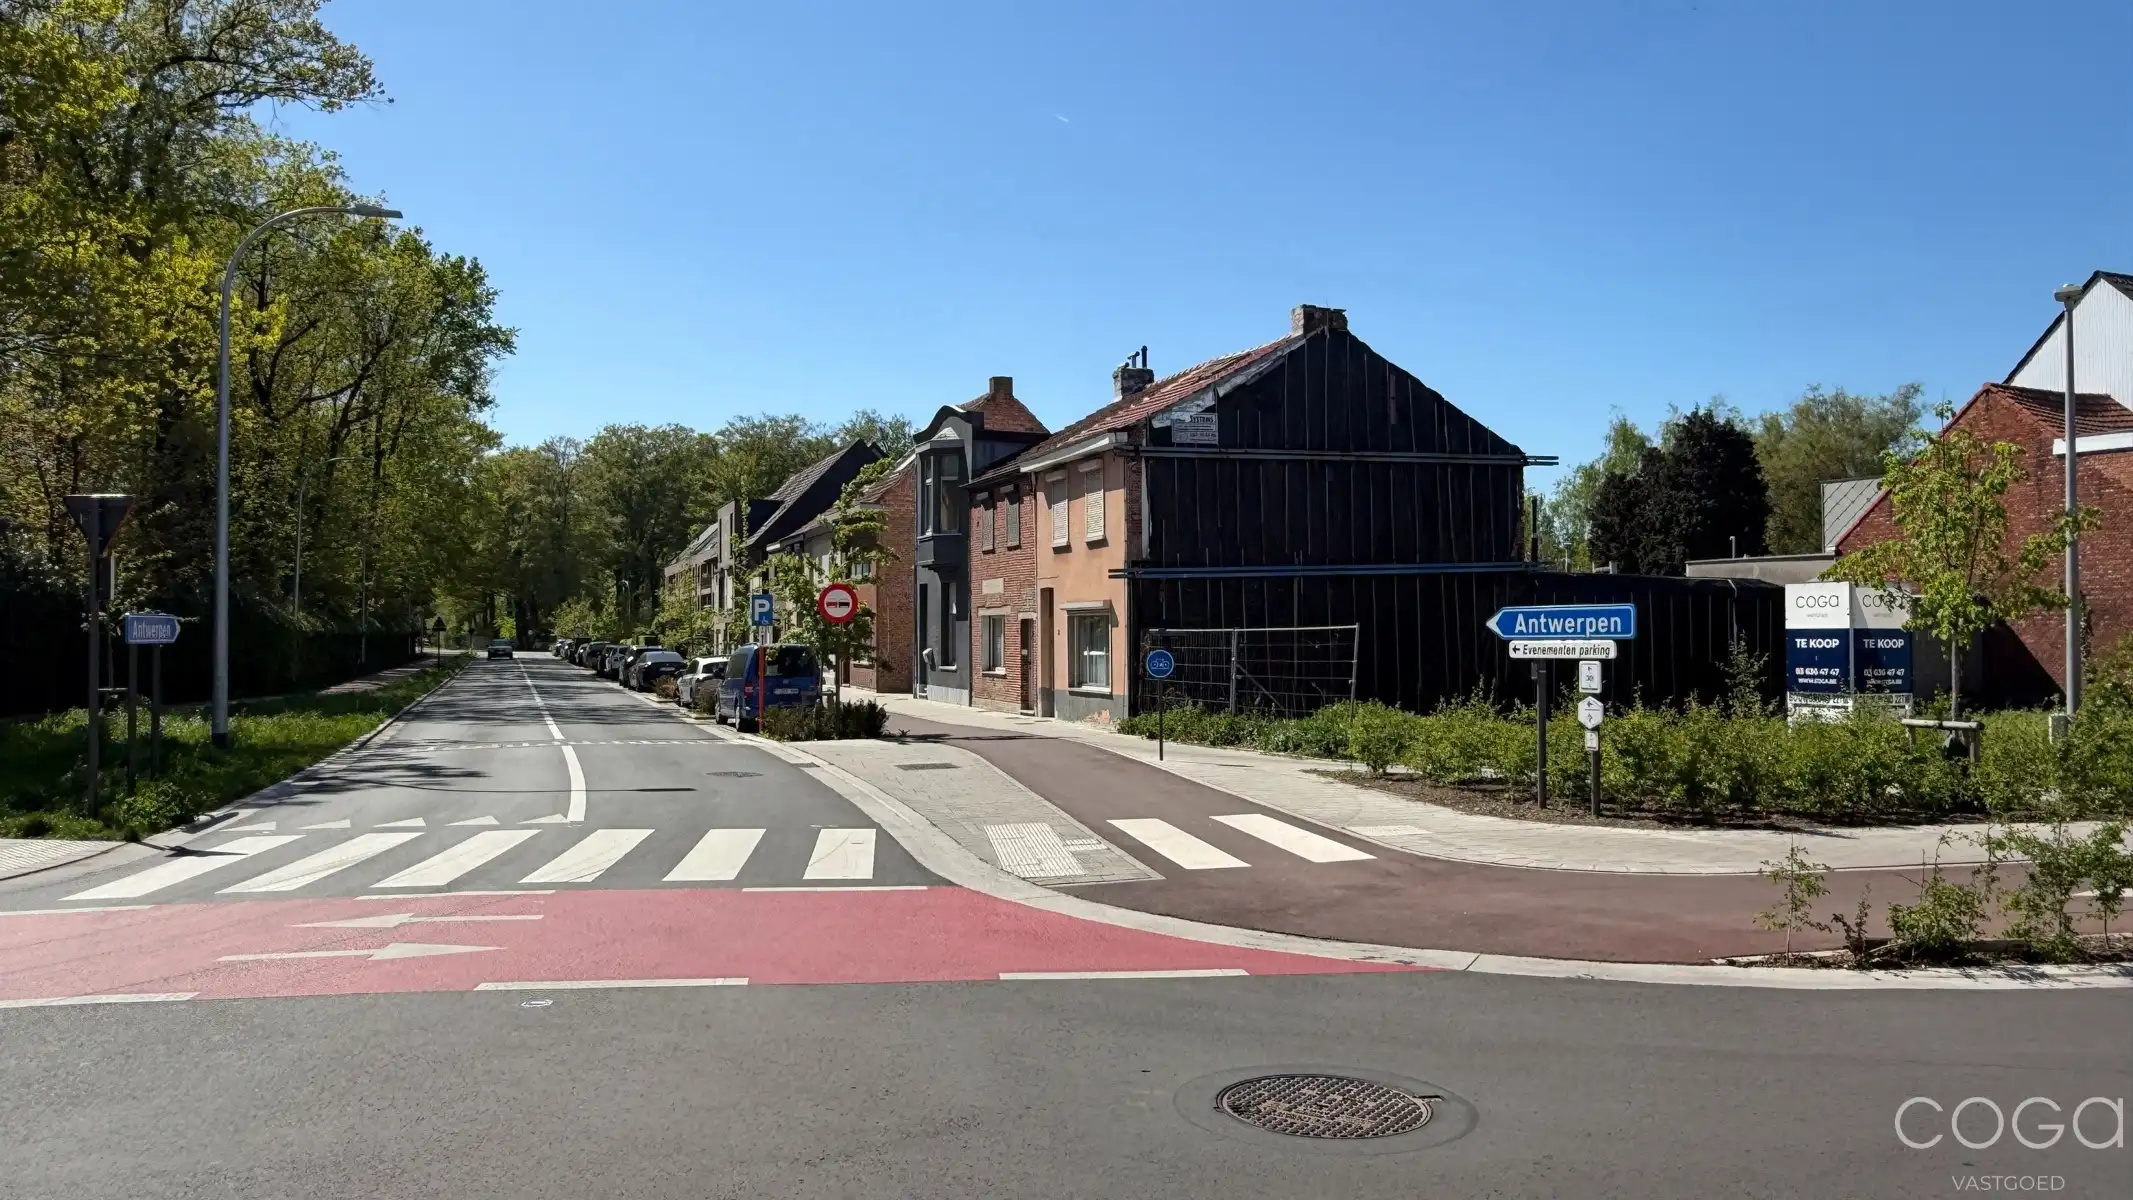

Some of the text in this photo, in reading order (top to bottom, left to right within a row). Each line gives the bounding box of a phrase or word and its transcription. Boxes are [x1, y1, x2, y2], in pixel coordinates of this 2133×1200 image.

[754, 598, 771, 621] P
[132, 619, 171, 640] Antwerpen
[1514, 613, 1622, 638] Antwerpen
[1795, 638, 1840, 649] TE KOOP
[1863, 639, 1905, 649] TE KOOP
[1522, 644, 1611, 658] Evenementen parking
[1819, 667, 1829, 676] 47
[1829, 667, 1840, 676] 47
